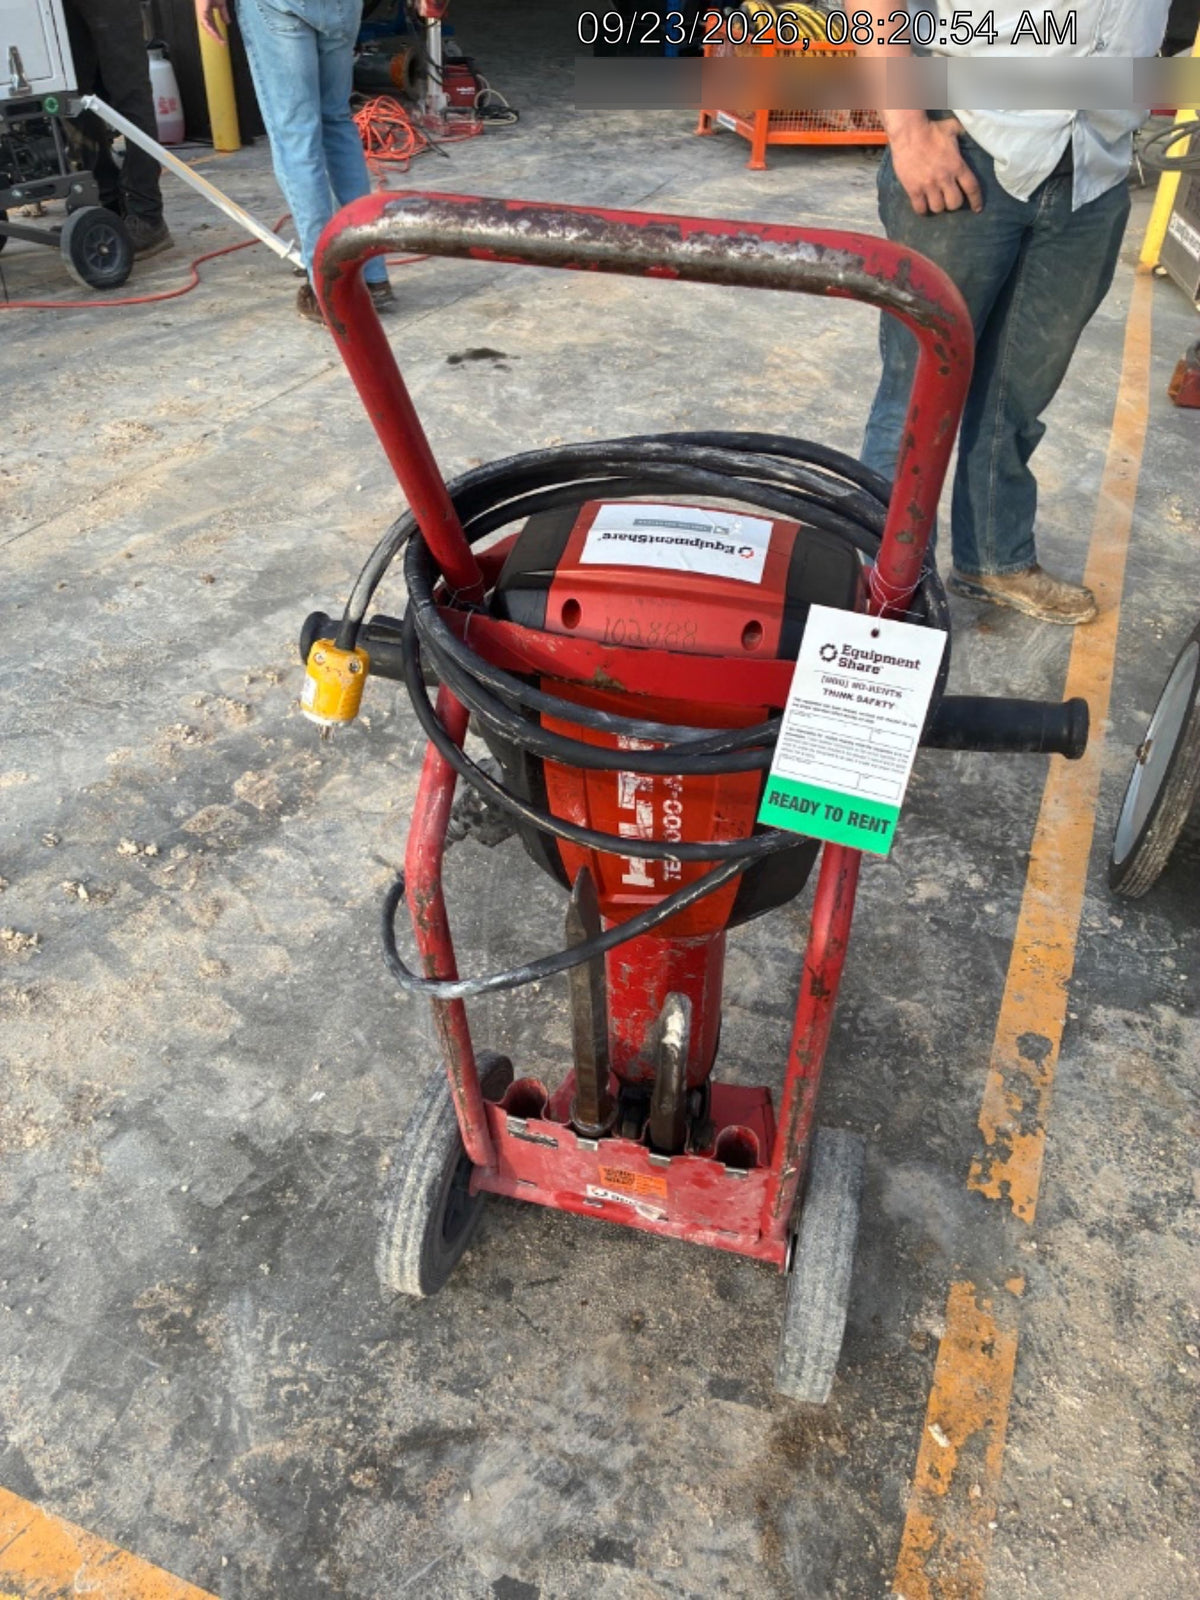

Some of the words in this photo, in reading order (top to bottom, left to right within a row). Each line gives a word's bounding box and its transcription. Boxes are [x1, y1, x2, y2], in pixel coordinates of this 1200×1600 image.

[601, 532, 736, 555] EquipmentShare
[838, 656, 882, 674] Share
[841, 643, 921, 670] Equipment
[822, 687, 854, 702] THINK
[856, 694, 896, 710] SAFETY
[768, 790, 820, 816] READY
[824, 803, 844, 823] TO
[847, 809, 892, 835] RENT
